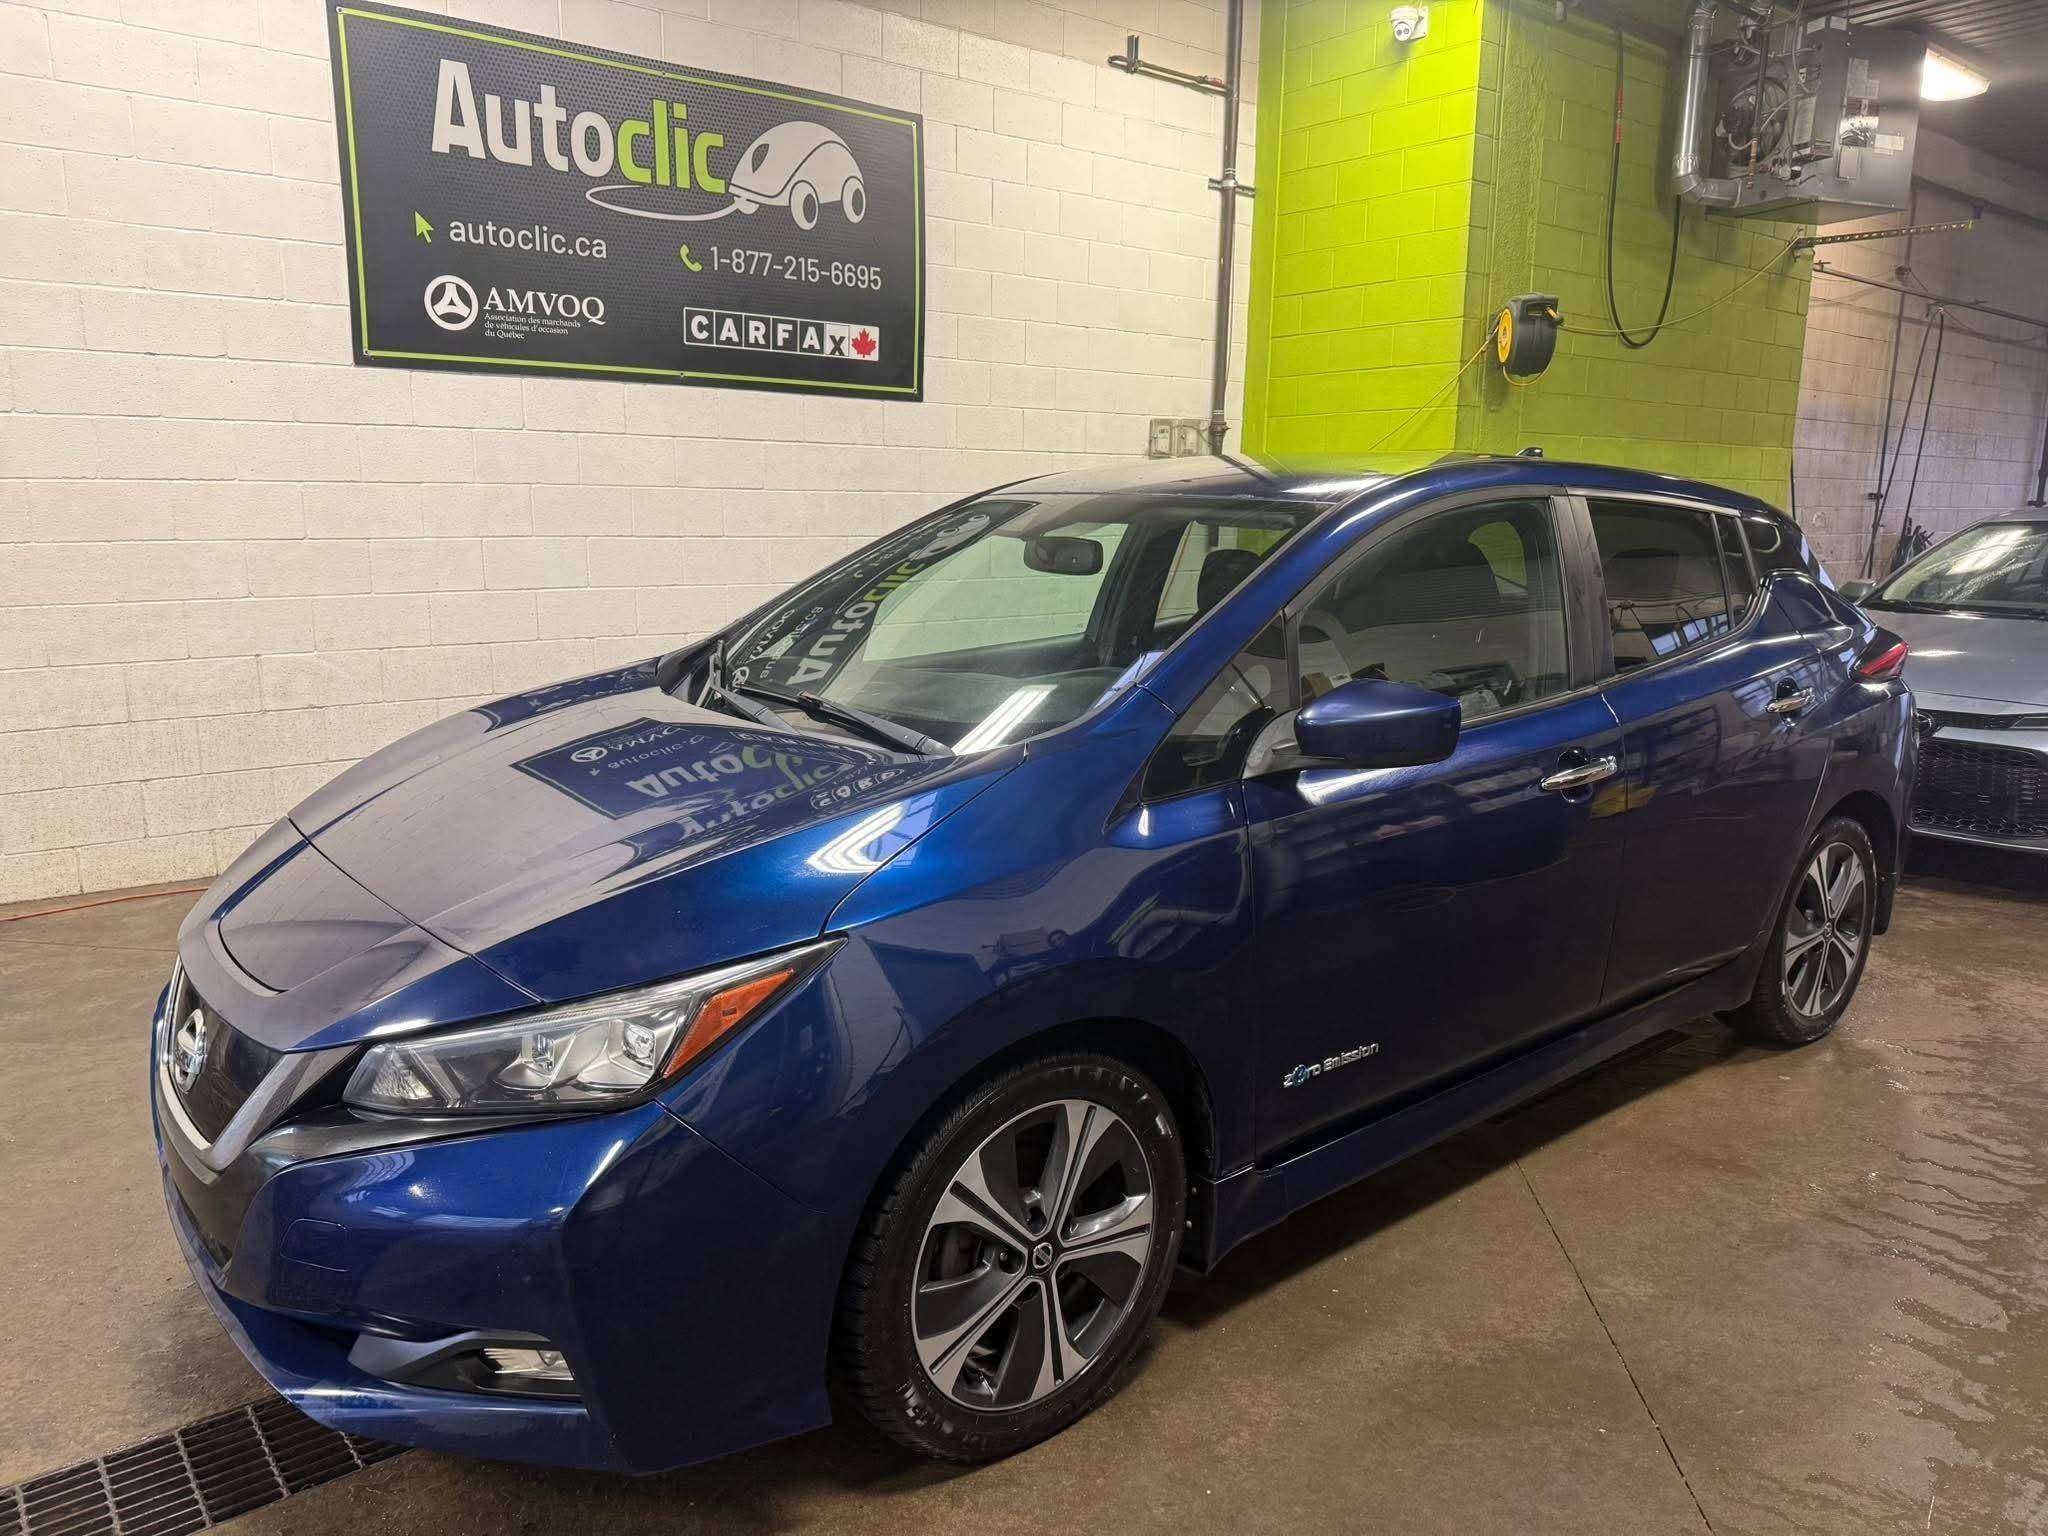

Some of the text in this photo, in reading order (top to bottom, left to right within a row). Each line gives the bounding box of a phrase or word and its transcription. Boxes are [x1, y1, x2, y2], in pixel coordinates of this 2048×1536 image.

[431, 58, 726, 194] Autoclic
[449, 220, 607, 259] autoclic.ca
[710, 246, 882, 290] 1-877-215-6695
[483, 286, 606, 325] AMVOQ
[484, 312, 581, 328] Association des marchands
[484, 320, 494, 329] de
[495, 322, 530, 332] véhicules
[484, 329, 526, 340] du Québec
[690, 314, 847, 357] CARFAX
[1322, 1042, 1380, 1073] Emission
